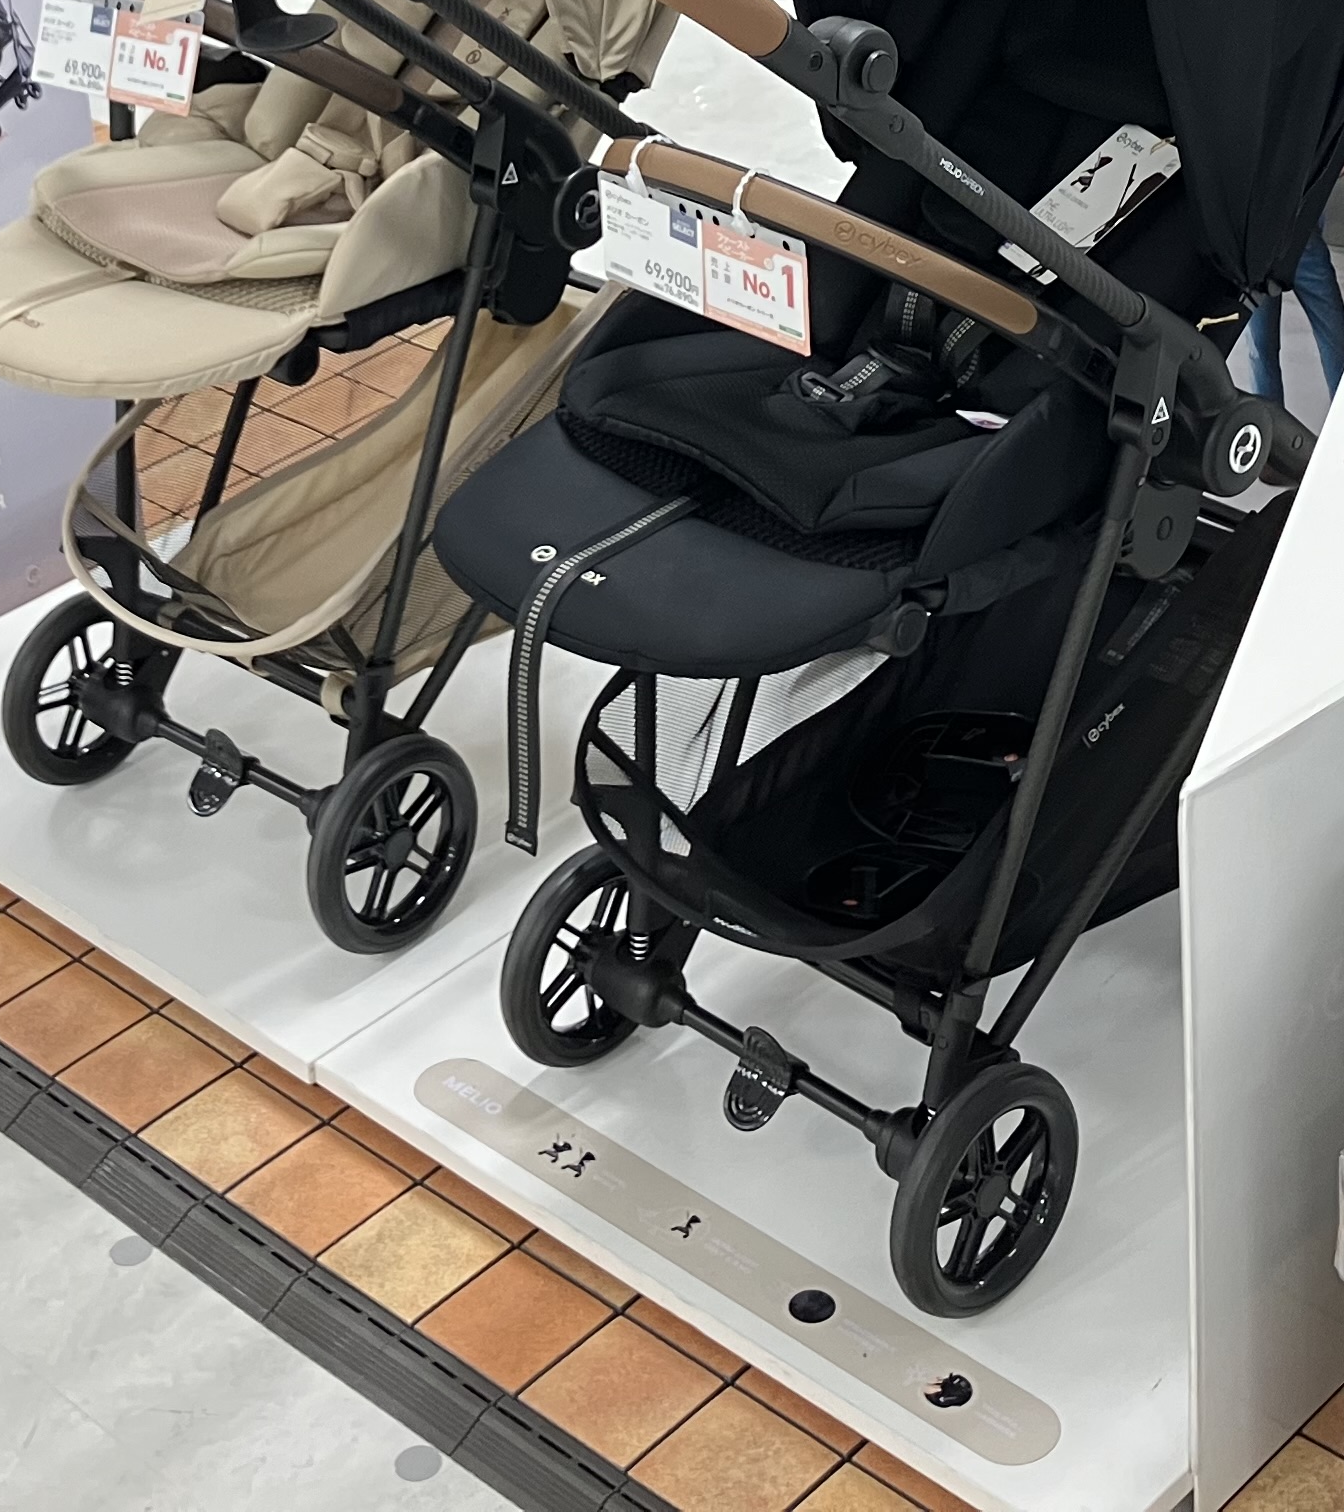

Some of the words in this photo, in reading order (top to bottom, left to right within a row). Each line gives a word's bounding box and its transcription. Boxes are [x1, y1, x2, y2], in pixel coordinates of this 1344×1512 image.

[144, 47, 170, 73] No.
[178, 36, 191, 76] 1
[939, 157, 962, 179] MELIO
[742, 269, 776, 303] No.
[781, 264, 795, 309] 1
[442, 1075, 504, 1116] MELIO
